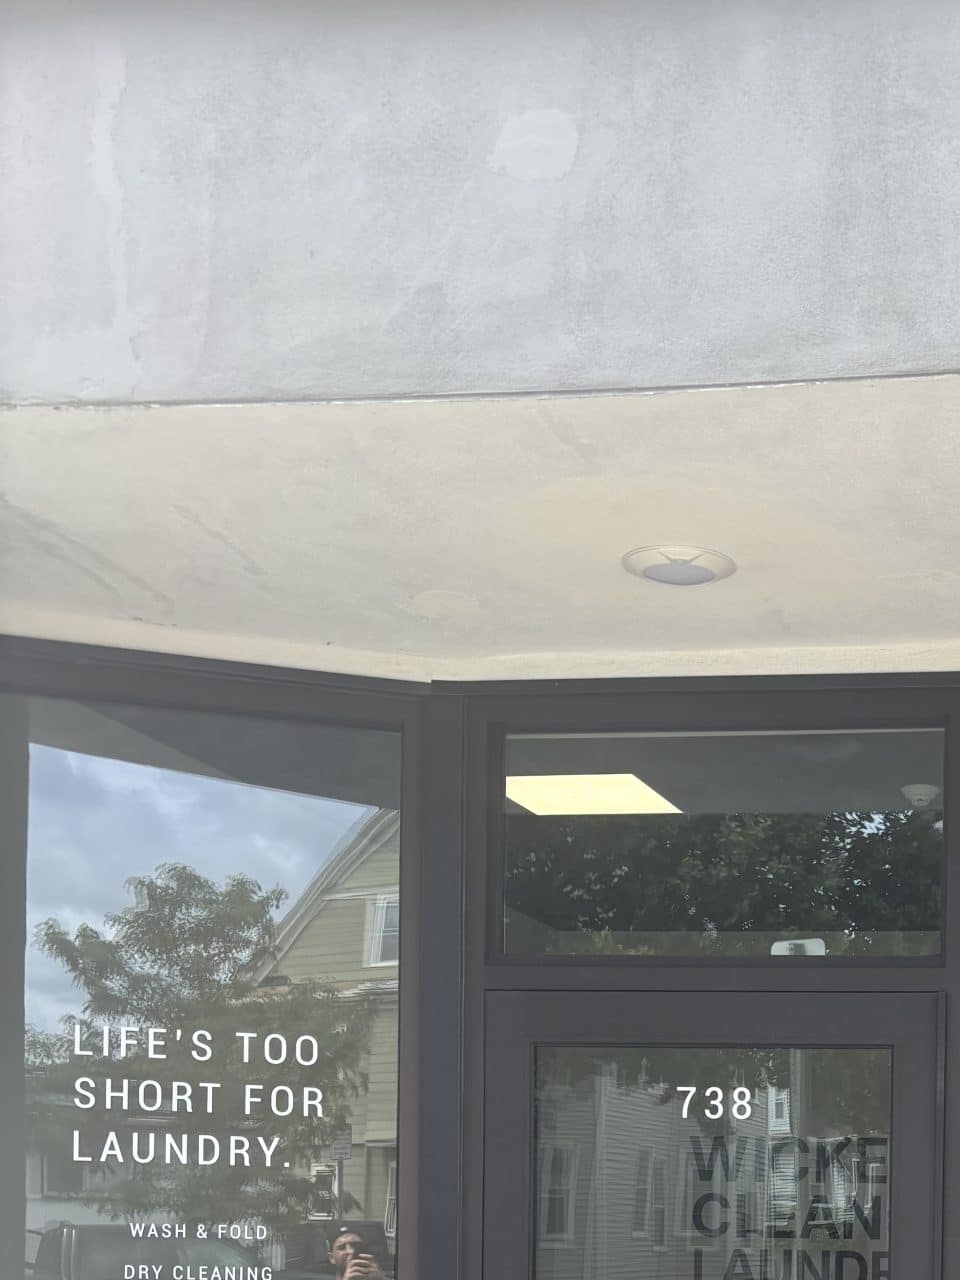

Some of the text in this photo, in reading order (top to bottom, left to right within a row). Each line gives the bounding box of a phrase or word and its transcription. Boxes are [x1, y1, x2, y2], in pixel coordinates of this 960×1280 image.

[73, 1024, 319, 1066] LIFE'S TOO
[73, 1077, 324, 1117] SHORT FOR
[676, 1086, 752, 1119] 738
[72, 1130, 290, 1168] LAUNDRY.
[129, 1223, 267, 1240] WASH & FOLD
[692, 1193, 881, 1240] CLEAN
[124, 1265, 163, 1280] DRY
